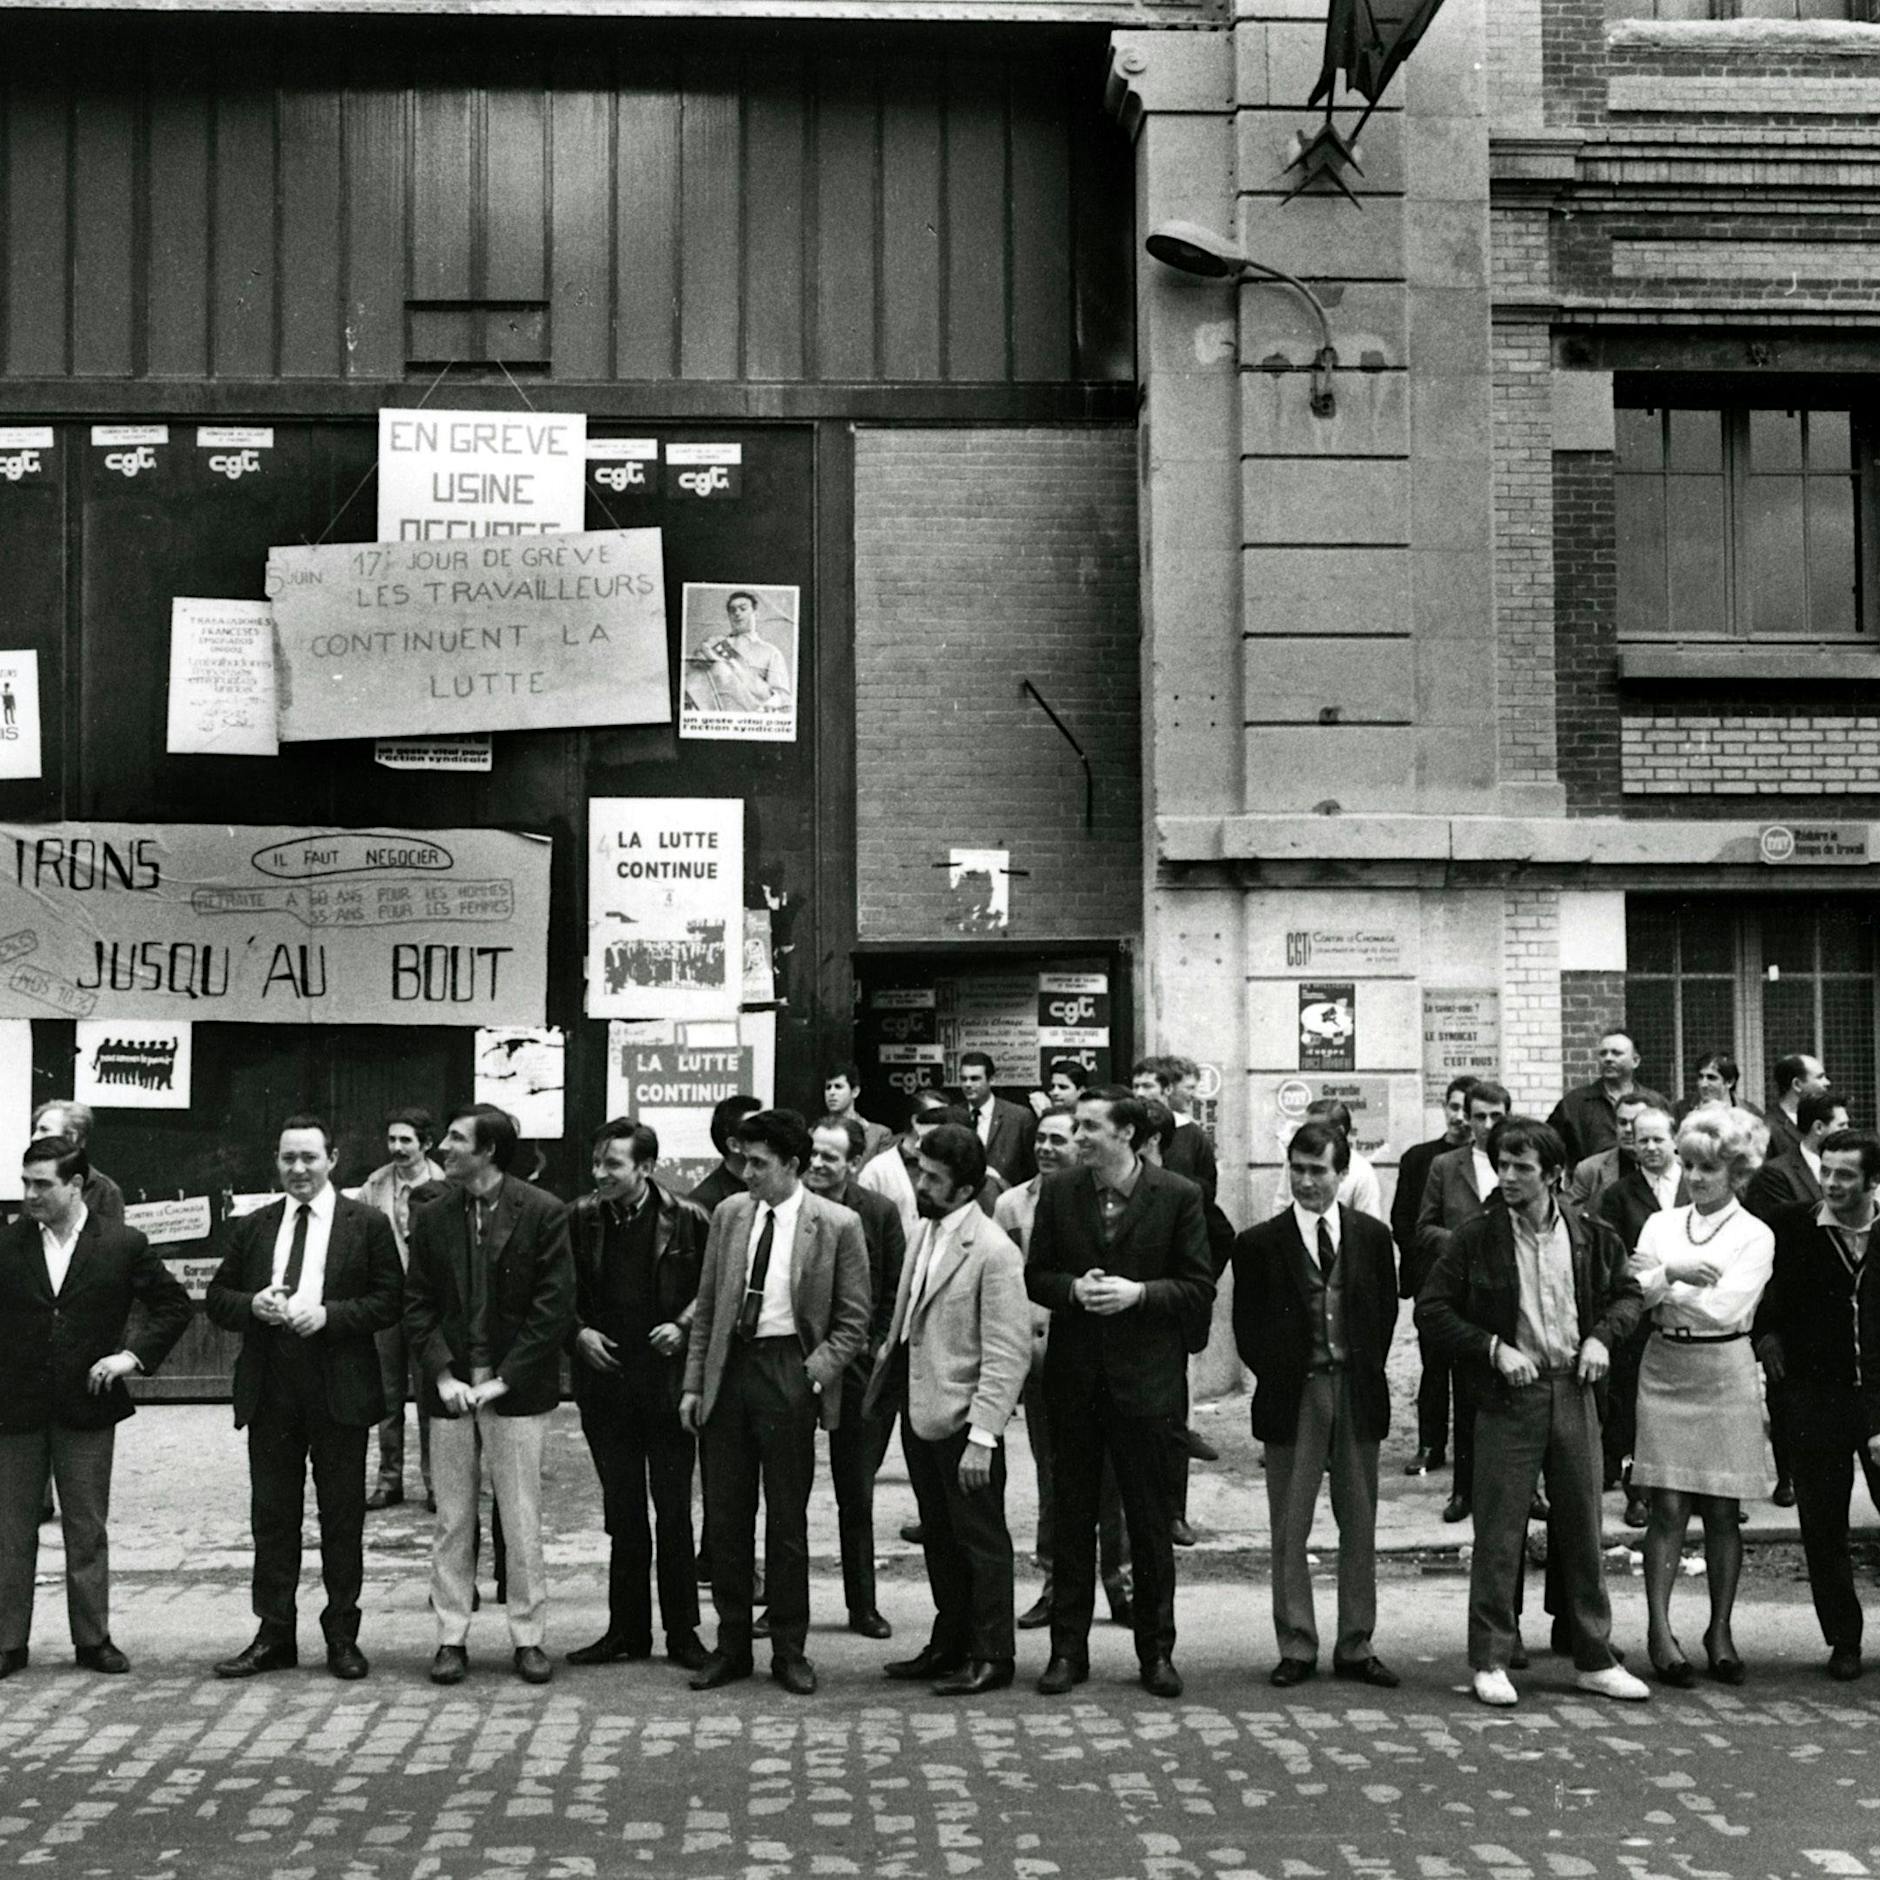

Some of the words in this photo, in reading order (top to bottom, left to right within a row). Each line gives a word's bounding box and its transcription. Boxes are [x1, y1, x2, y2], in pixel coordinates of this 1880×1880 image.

[390, 420, 438, 453] EN
[450, 422, 569, 456] GREVE
[433, 471, 536, 506] USINE
[407, 551, 470, 571] JOUR
[484, 547, 513, 568] DE
[357, 583, 411, 609] LES
[423, 573, 656, 605] TRAVAILLEURS
[311, 623, 529, 659] CONTINUENT
[562, 622, 611, 647] LA
[430, 671, 546, 700] LUTTE
[617, 831, 642, 849] LA
[659, 831, 719, 849] LUTTE
[15, 838, 162, 891] IRONS
[274, 853, 288, 868] IL
[303, 850, 341, 866] FAUT
[366, 848, 439, 868] NEGOCIER
[616, 861, 719, 880] CONTINUE
[378, 886, 411, 903] POUR
[426, 884, 448, 901] LES
[378, 903, 412, 919] POUR
[426, 901, 448, 917] LES
[1286, 931, 1308, 967] CGT
[76, 935, 327, 999] JUSQU'AU
[392, 943, 514, 1003] BOUT
[637, 1053, 662, 1072] LA
[678, 1053, 739, 1072] LUTTE
[636, 1082, 739, 1102] CONTINUE
